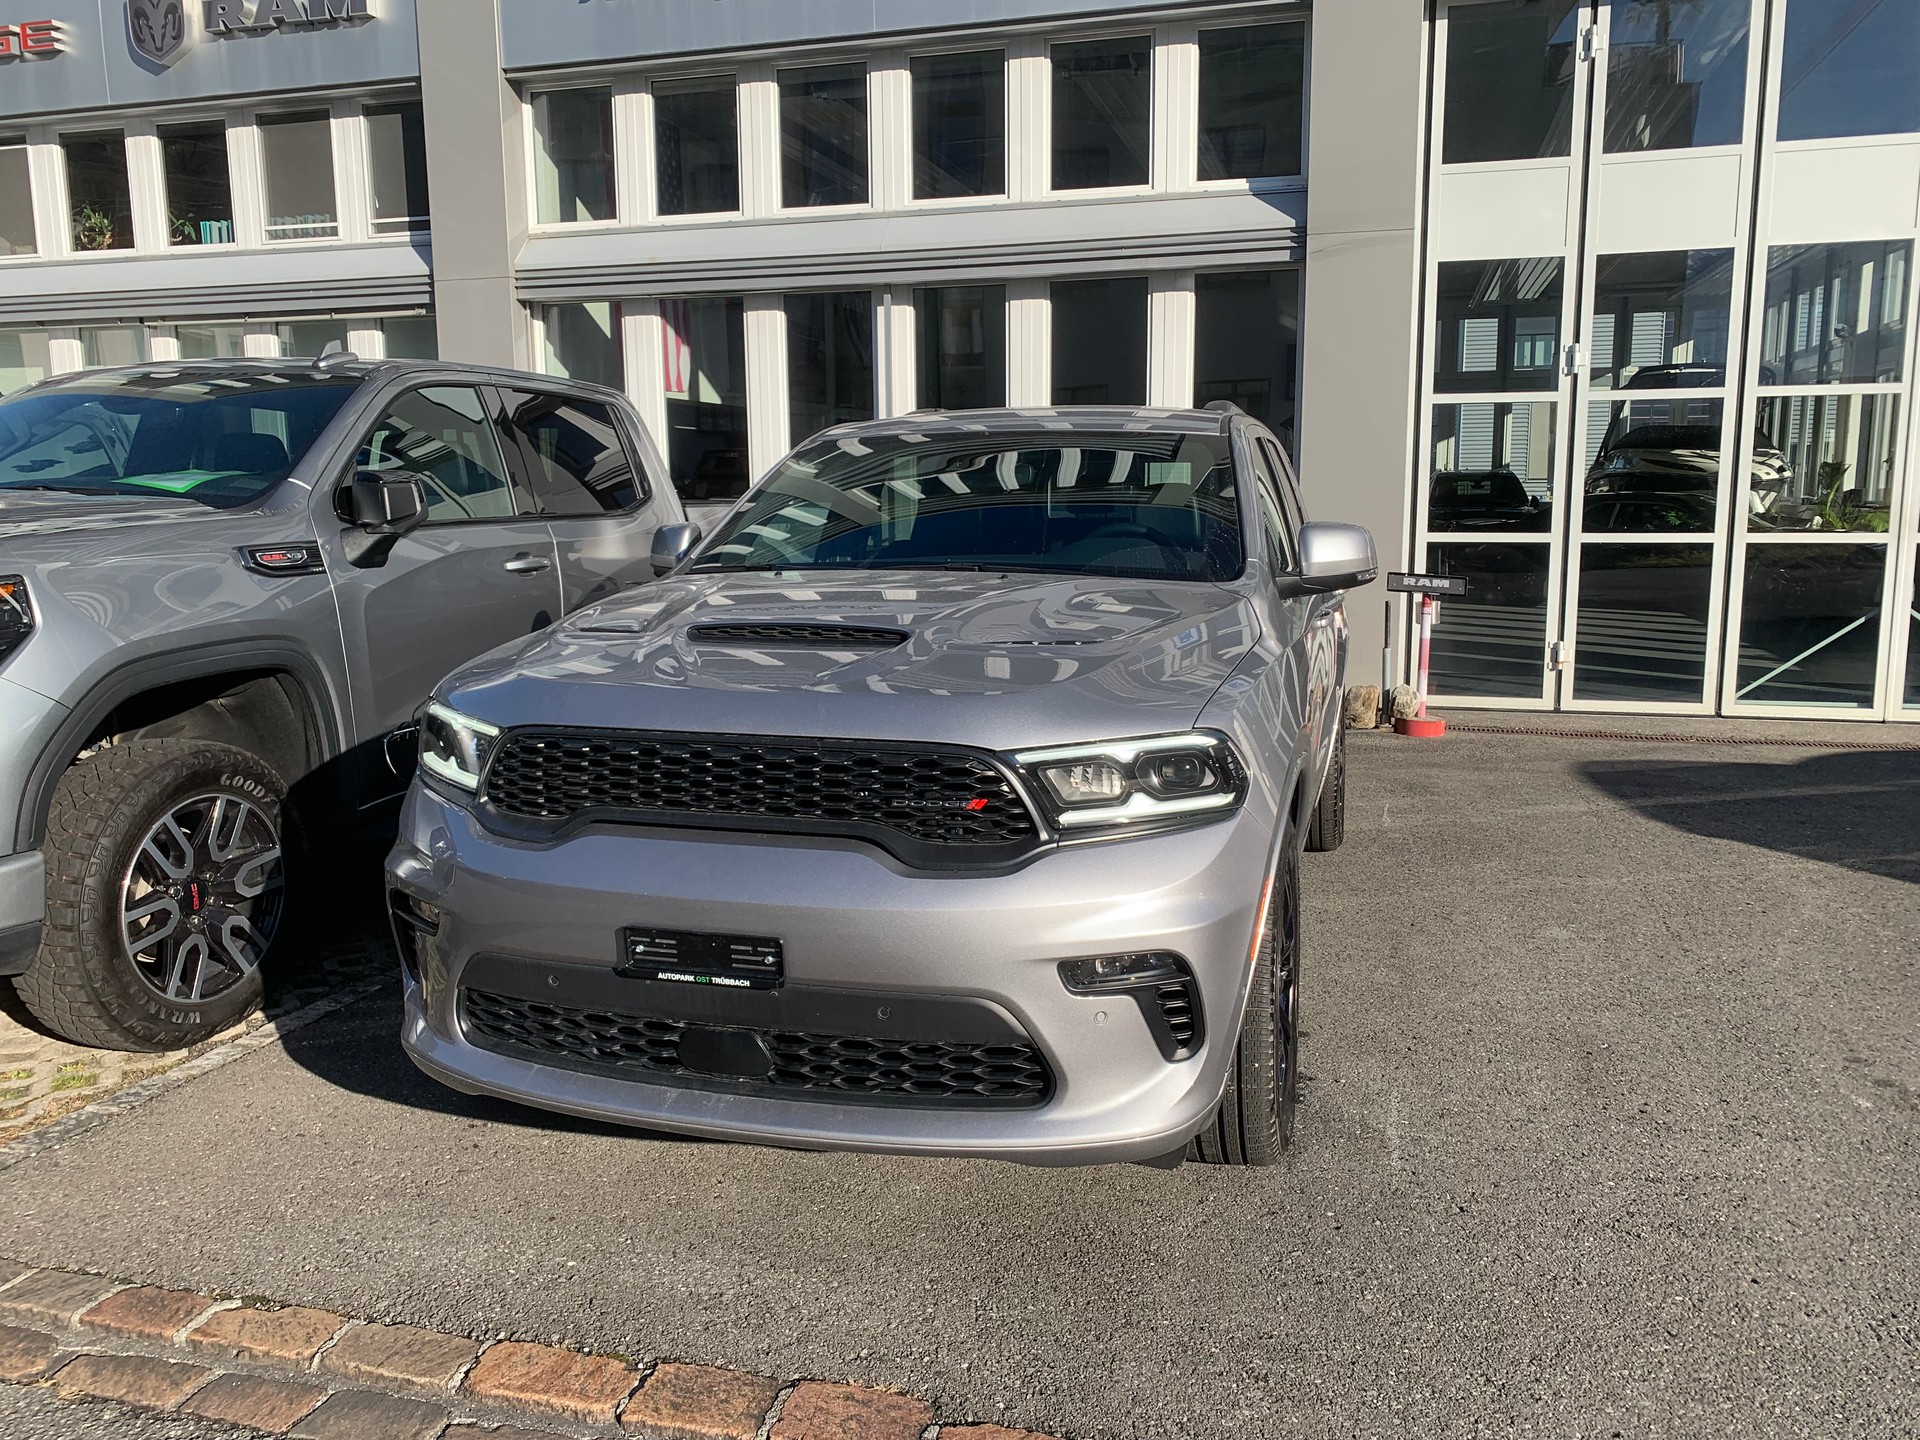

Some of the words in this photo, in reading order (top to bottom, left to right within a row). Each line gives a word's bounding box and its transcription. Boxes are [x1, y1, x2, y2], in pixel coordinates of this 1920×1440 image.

[1403, 577, 1450, 588] RAM
[220, 773, 266, 798] GOOD
[190, 882, 200, 910] GMC
[657, 972, 696, 982] AUTOPARK
[711, 976, 750, 987] TRÜBBACH
